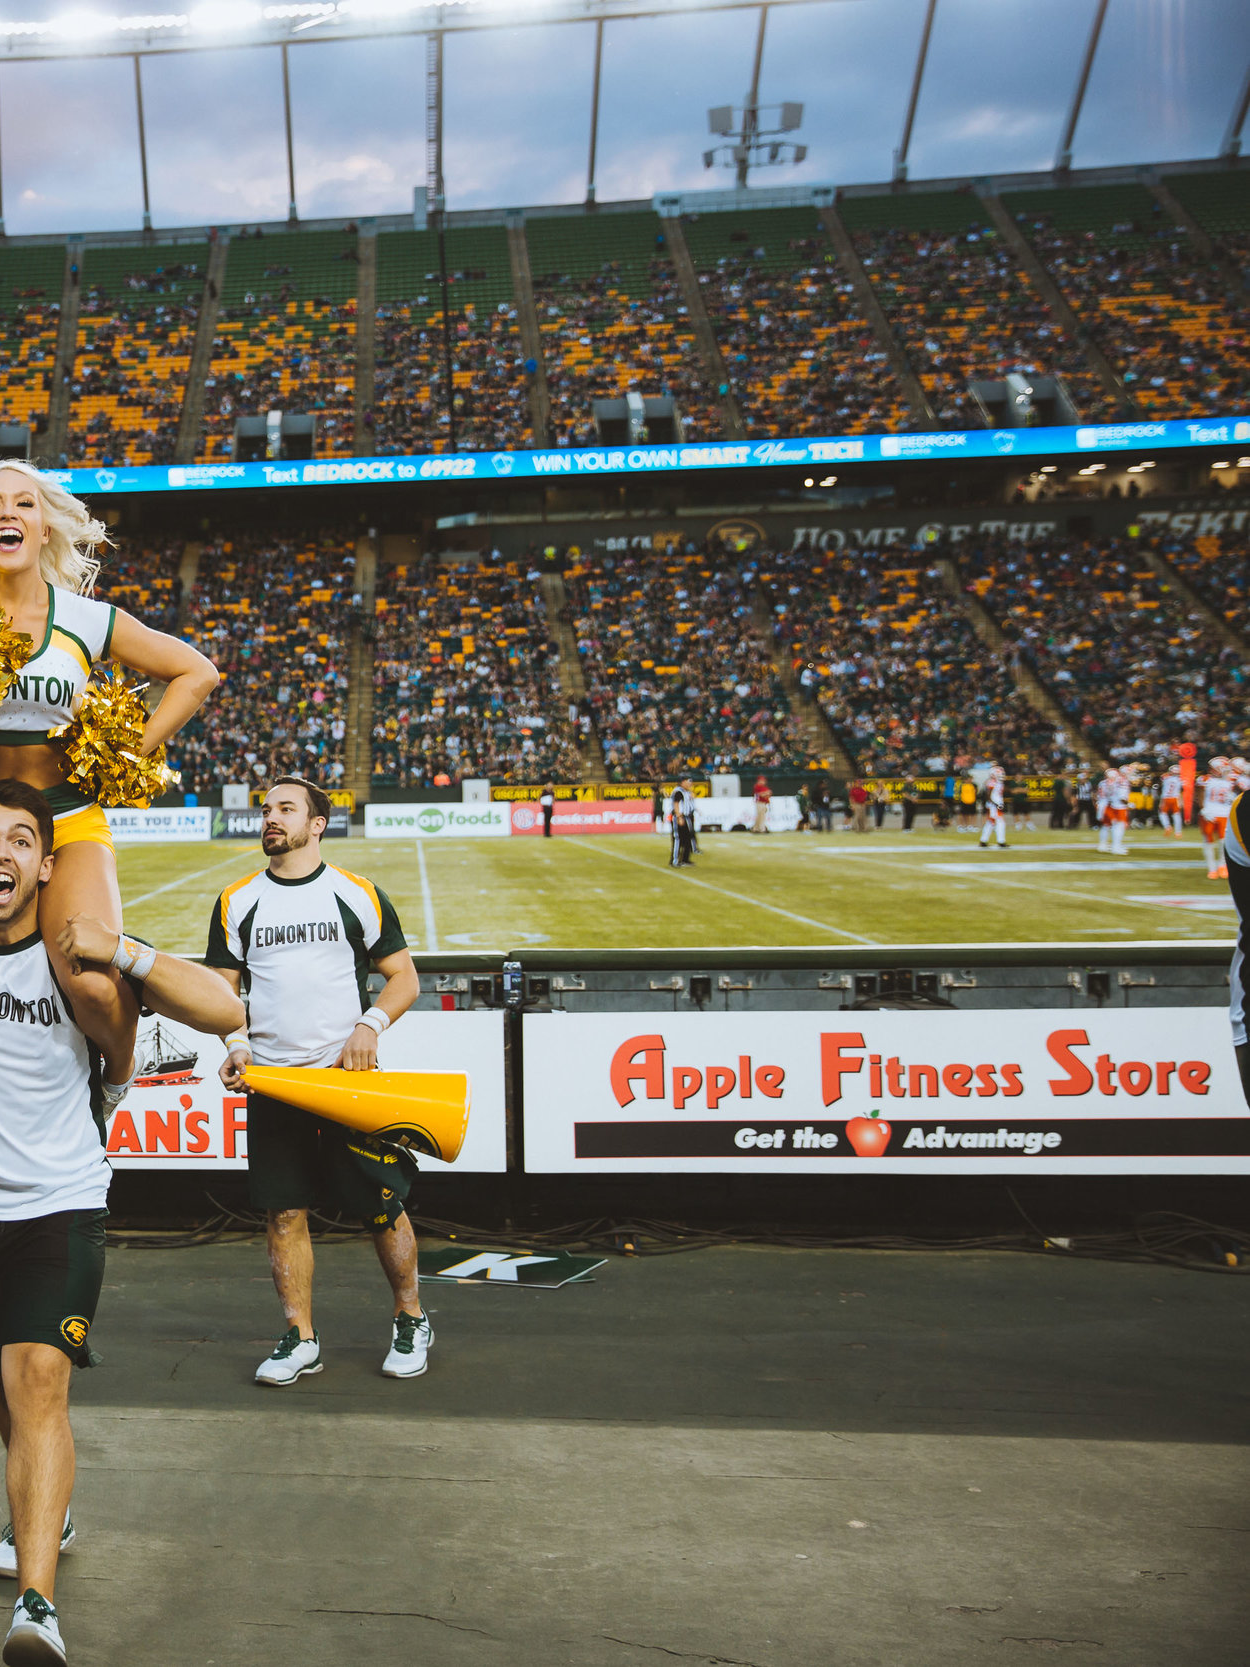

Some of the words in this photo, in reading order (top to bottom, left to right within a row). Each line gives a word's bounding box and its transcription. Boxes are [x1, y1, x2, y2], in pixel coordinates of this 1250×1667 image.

[1186, 424, 1229, 443] Text
[532, 454, 571, 472] WIN
[573, 452, 625, 470] YOUR
[627, 449, 677, 468] OWN
[679, 446, 751, 466] SMART
[808, 441, 864, 460] TECH
[185, 466, 245, 479] BEDROCK
[262, 466, 299, 483] Text
[302, 462, 395, 482] BEDROCK
[397, 464, 416, 478] to
[420, 458, 476, 477] 69922
[3, 675, 75, 708] NTON
[574, 787, 595, 803] 14
[110, 816, 138, 826] ARE
[144, 816, 172, 826] YOU
[177, 815, 206, 826] IN?
[374, 816, 415, 827] save
[419, 814, 444, 827] on
[449, 811, 502, 825] foods
[255, 920, 340, 949] EDMONTON
[610, 1033, 785, 1109] Apple
[820, 1032, 1025, 1107] Fitness
[1046, 1028, 1212, 1097] Store
[734, 1126, 788, 1150] Get
[792, 1126, 838, 1150] the
[903, 1126, 1062, 1153] Advantage
[436, 1252, 559, 1281] K
